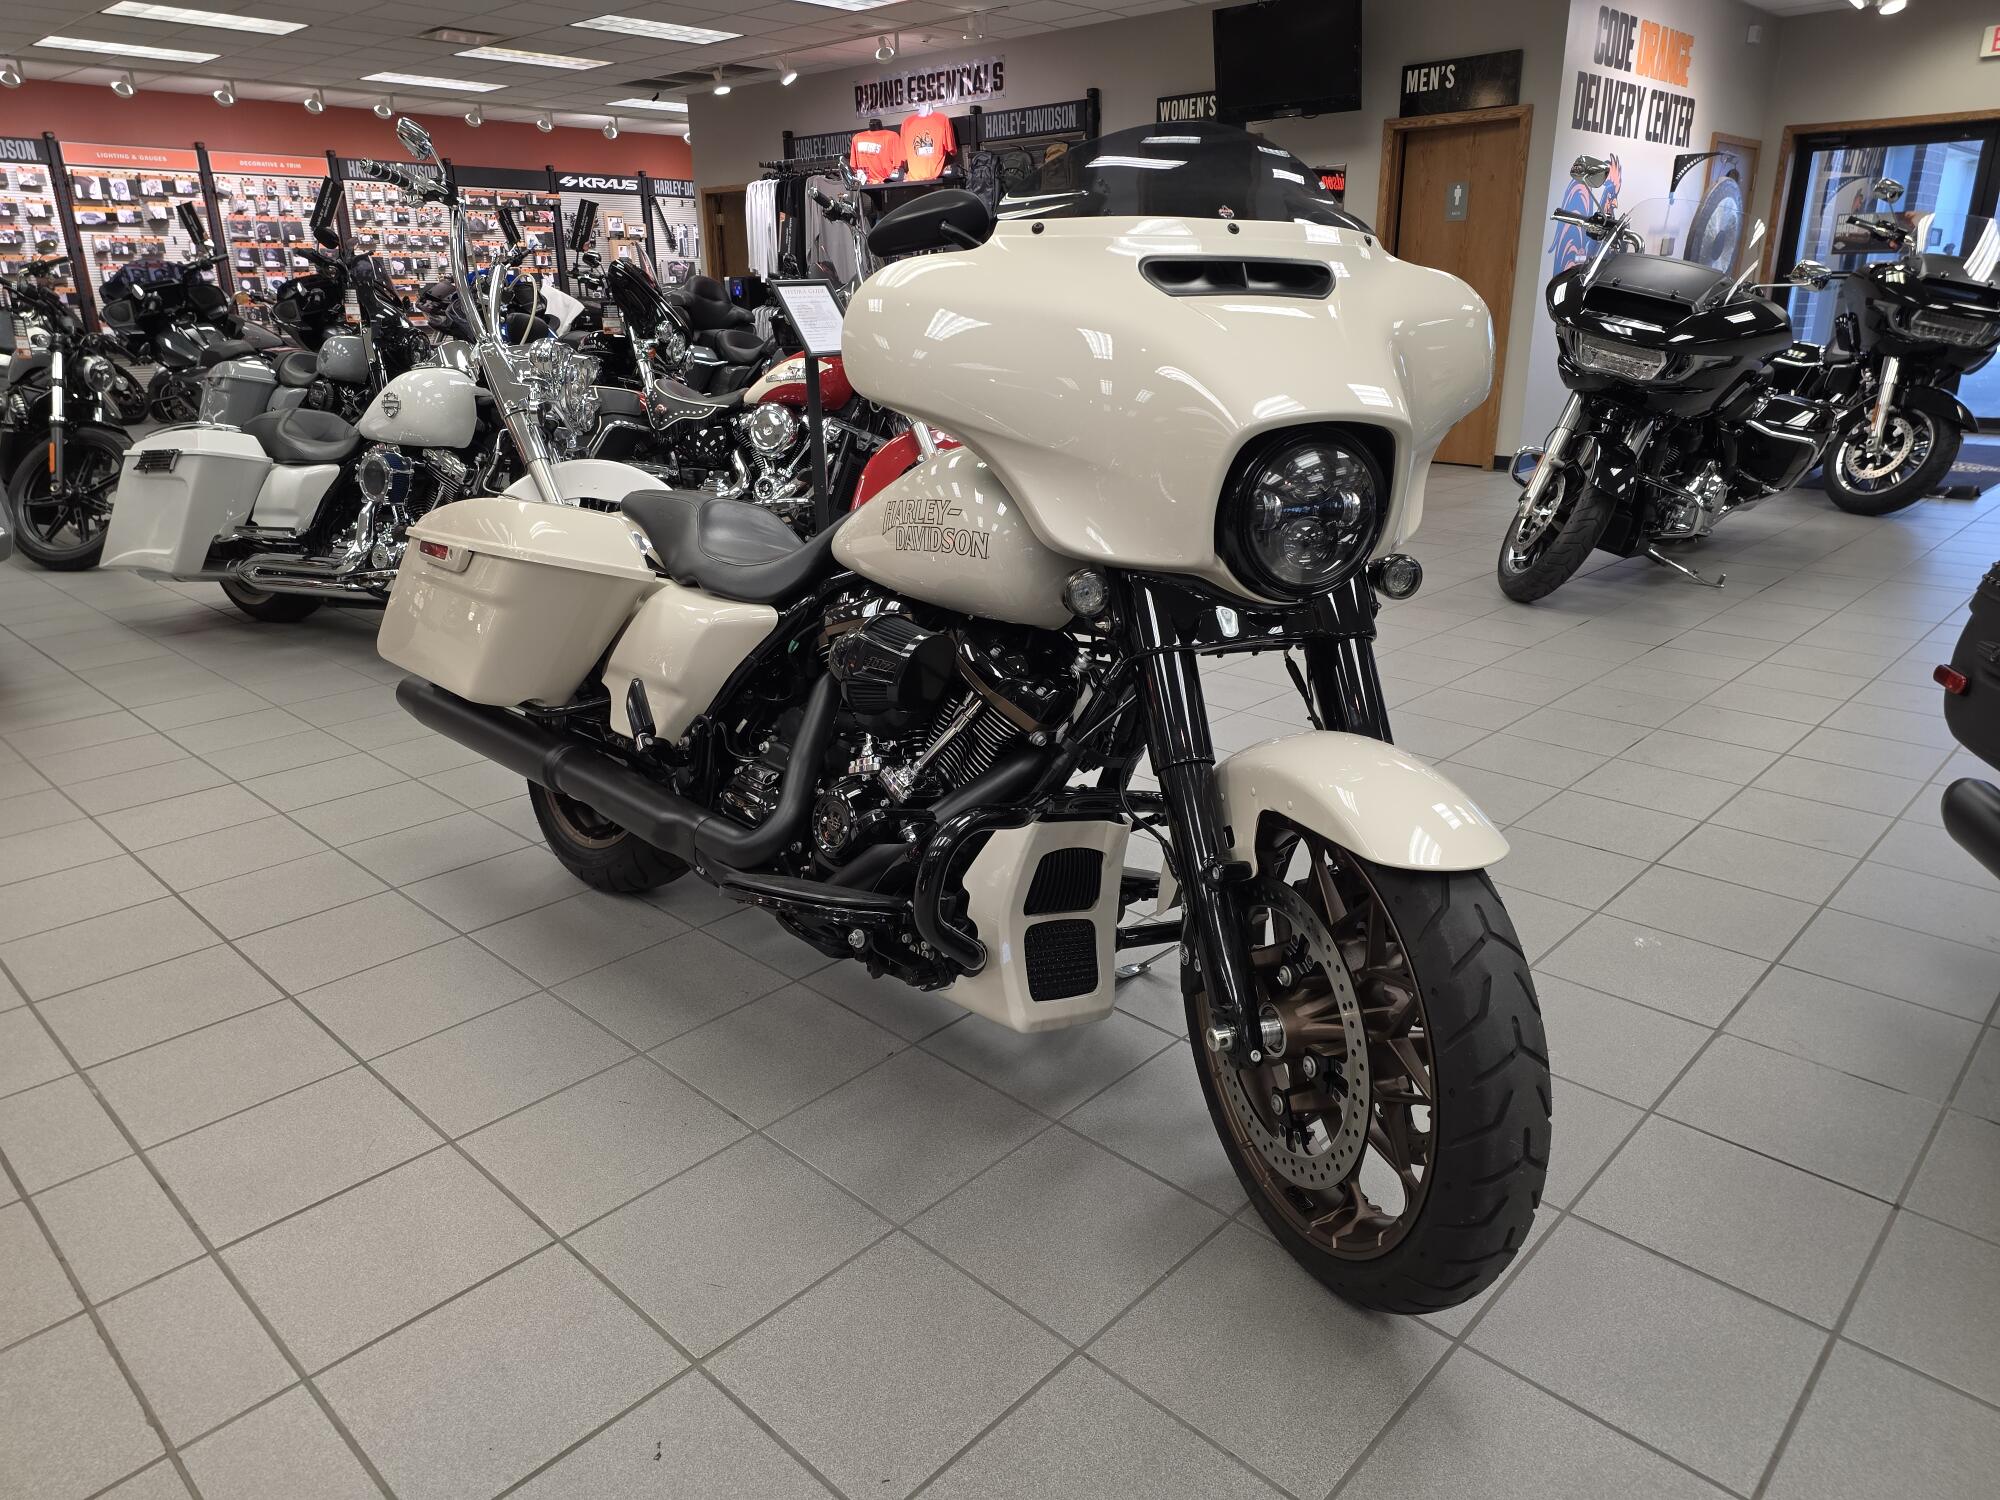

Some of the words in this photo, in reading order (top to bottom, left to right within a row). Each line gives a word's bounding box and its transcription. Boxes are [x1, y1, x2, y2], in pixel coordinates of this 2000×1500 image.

[1593, 5, 1638, 72] CODE
[1636, 19, 1695, 88] ORANGE
[854, 79, 905, 113] RIDING
[907, 62, 1004, 103] ESSENTIALS
[1405, 64, 1456, 94] MEN'S
[985, 104, 1077, 138] HARLEY-DAVIDSON
[1159, 95, 1217, 122] WOMEN'S
[1571, 71, 1647, 139] DELIVERY
[1645, 89, 1696, 148] CENTER
[96, 152, 130, 160] LIGHTING
[579, 176, 638, 191] KRAUS
[895, 526, 990, 560] DAVIDSON
